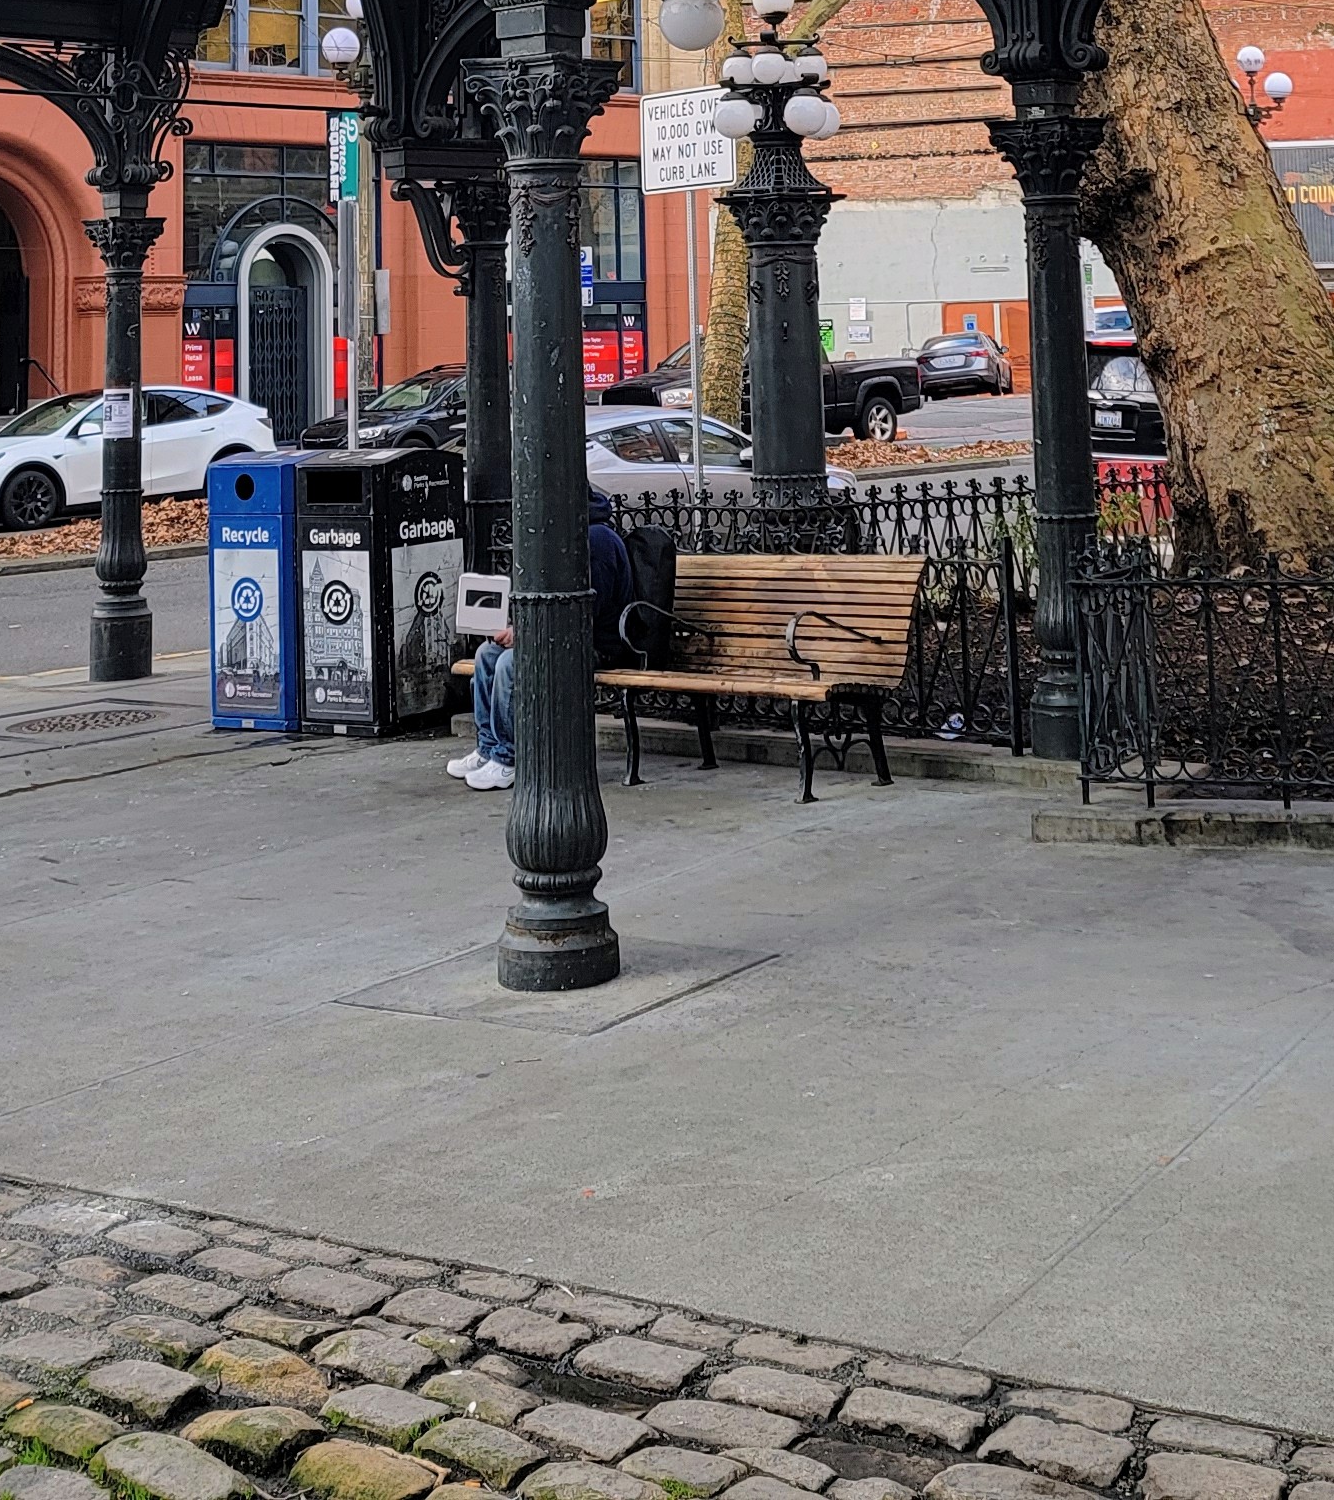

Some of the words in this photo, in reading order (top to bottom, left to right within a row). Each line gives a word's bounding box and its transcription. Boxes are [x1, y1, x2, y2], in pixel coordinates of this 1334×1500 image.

[648, 100, 694, 121] VEHICLES
[329, 117, 340, 202] SQUARE
[339, 116, 359, 184] Pioneer
[652, 146, 672, 163] MAY
[678, 142, 697, 159] NOT
[703, 139, 723, 156] USE
[659, 165, 685, 183] CURB
[691, 161, 717, 179] LANE
[185, 322, 200, 336] W
[623, 316, 635, 327] W
[184, 344, 203, 352] Prime
[184, 364, 196, 372] For
[221, 526, 269, 546] Recycle
[309, 528, 361, 548] Garbage
[399, 517, 455, 540] Garbage
